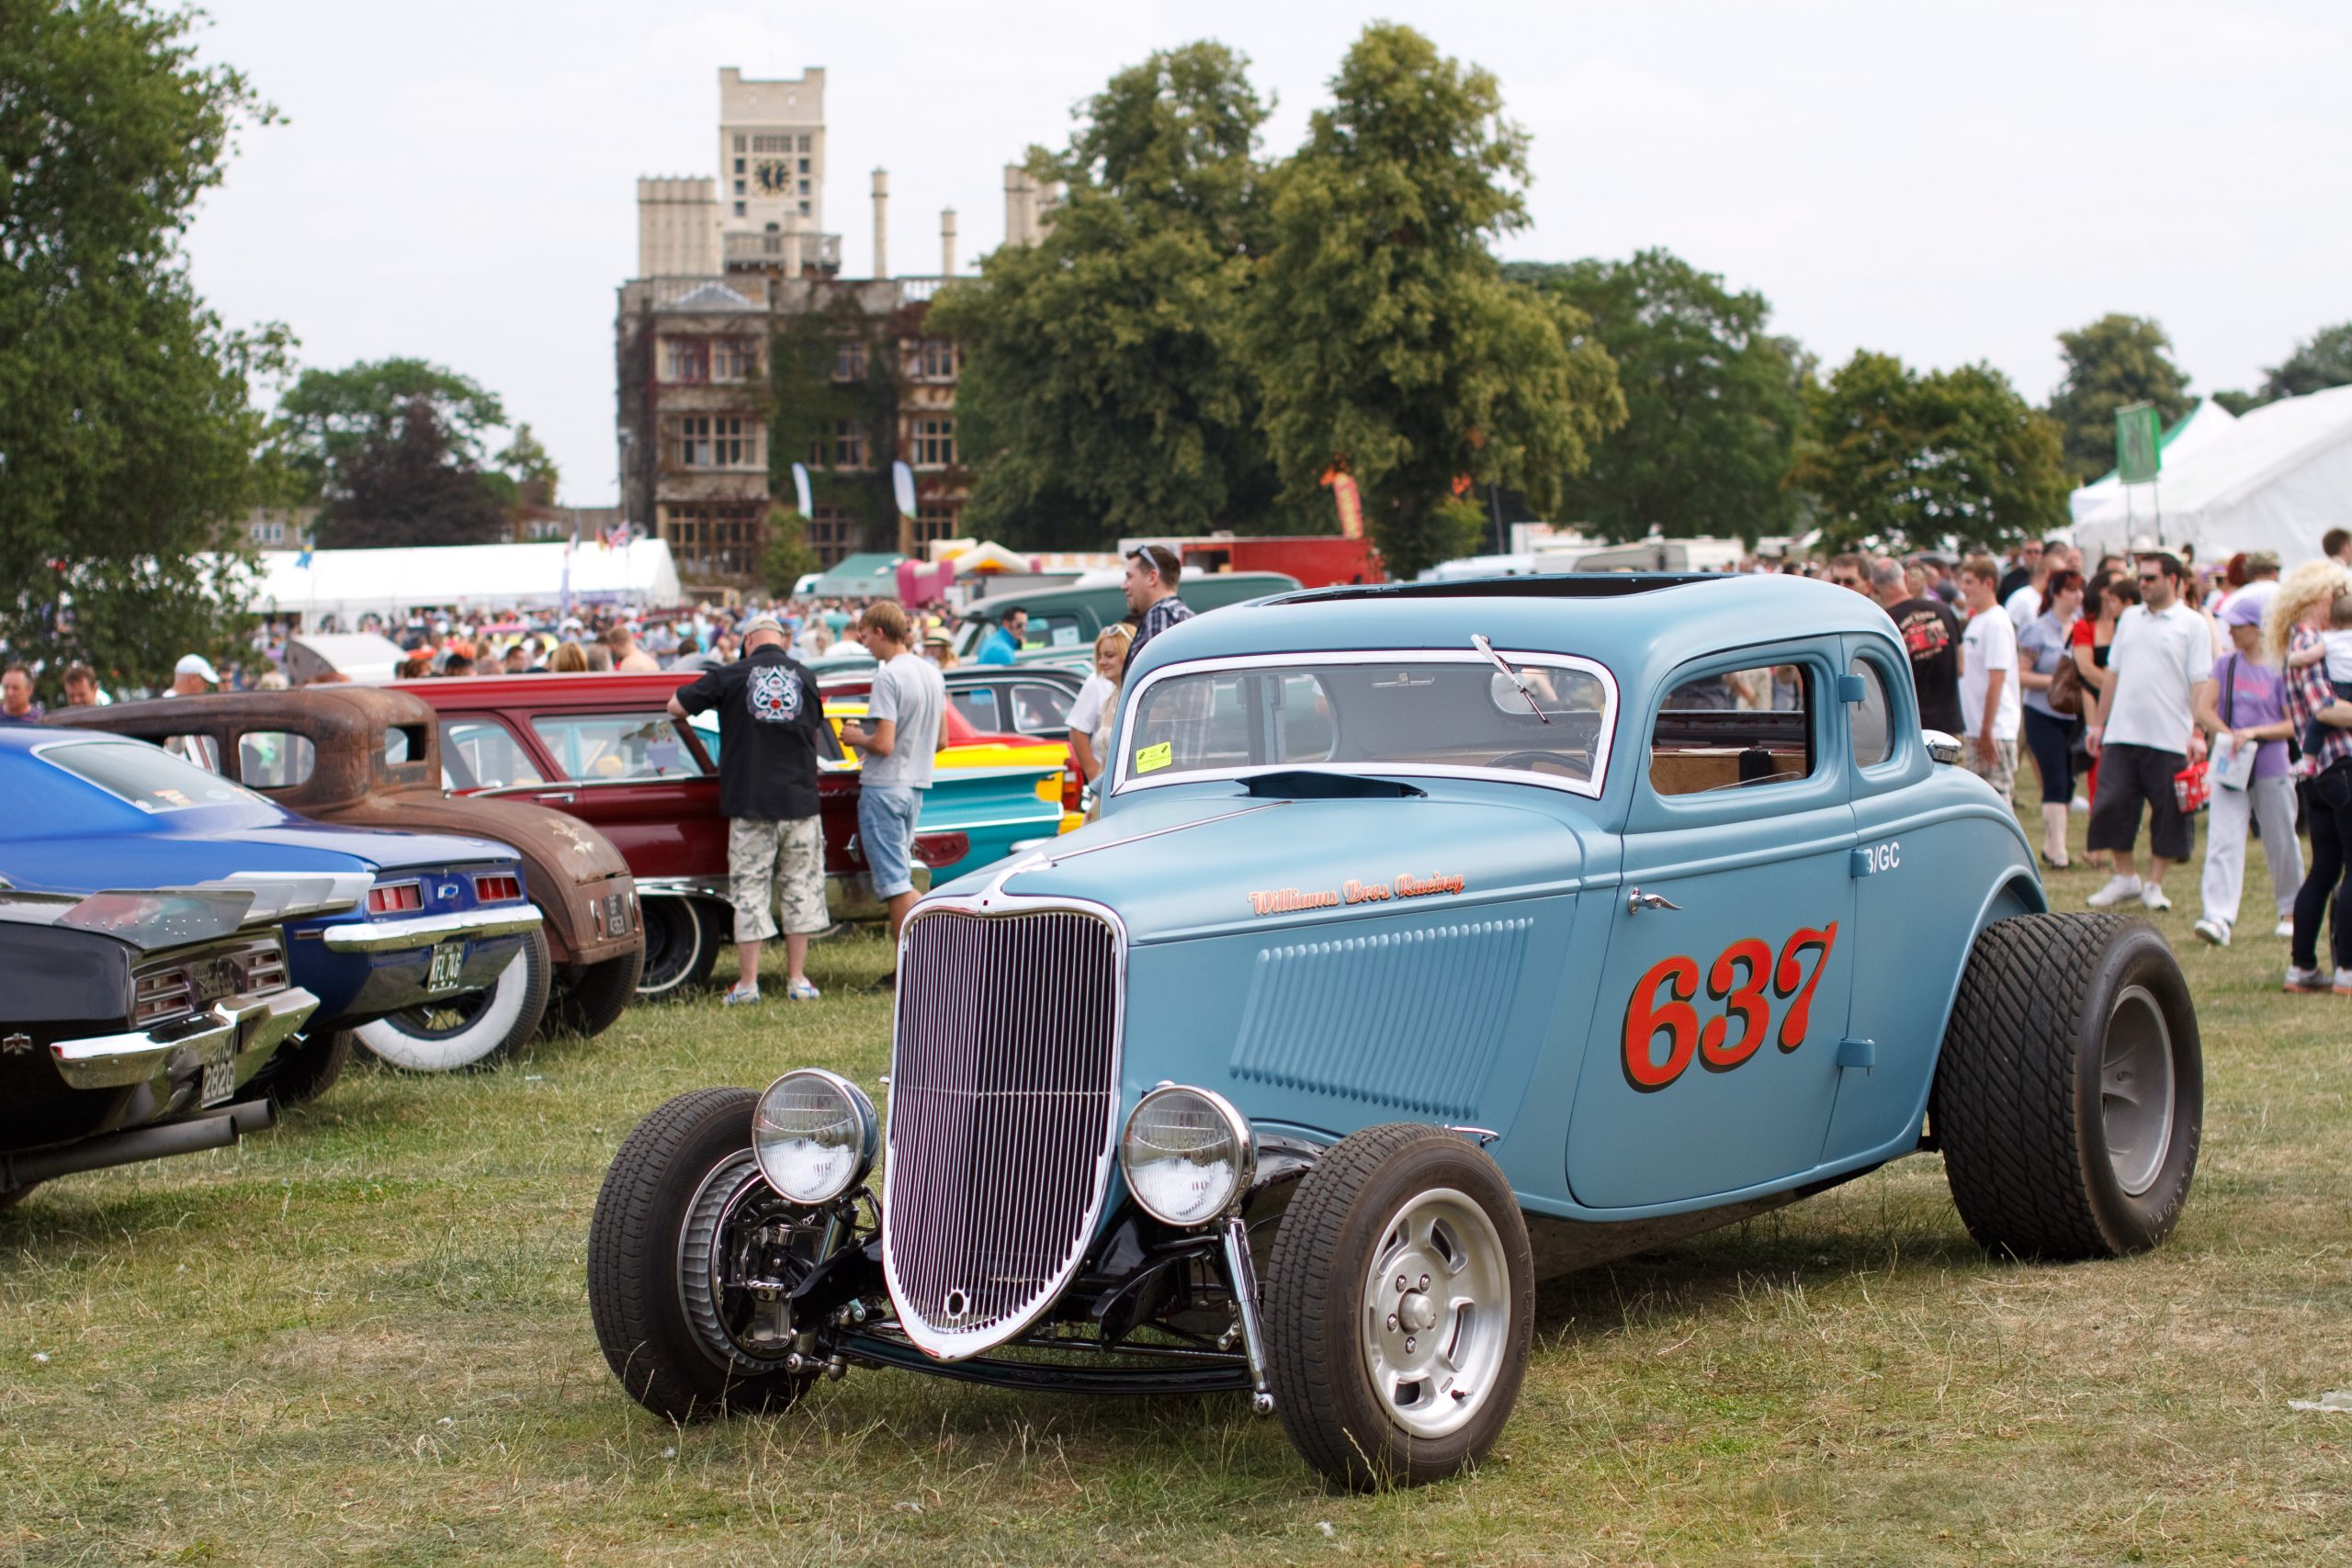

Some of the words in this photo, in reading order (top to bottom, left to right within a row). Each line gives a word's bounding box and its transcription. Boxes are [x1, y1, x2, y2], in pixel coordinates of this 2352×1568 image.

[1249, 887, 1340, 917] Williams
[1342, 878, 1391, 906] Bros
[1393, 871, 1465, 900] Racing
[1621, 920, 1838, 1094] 637
[203, 1060, 234, 1100] 282G
